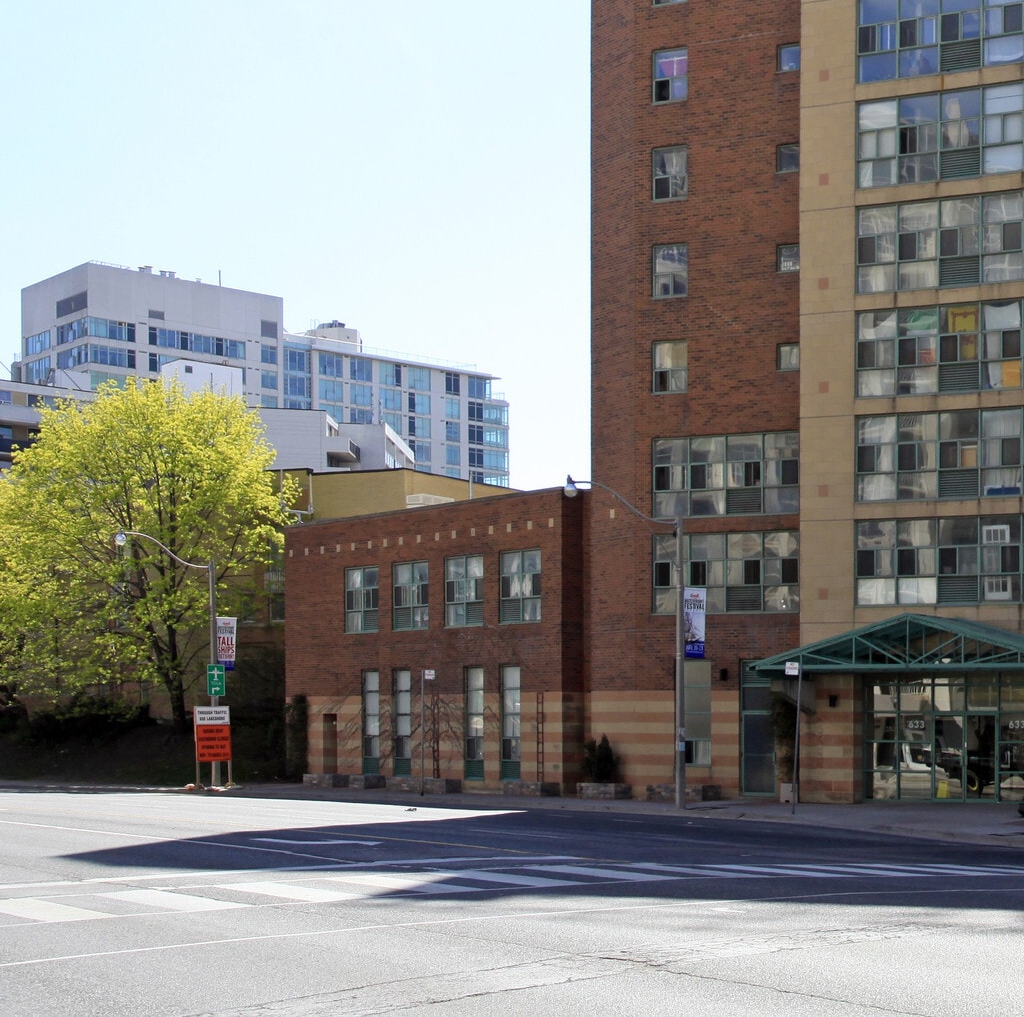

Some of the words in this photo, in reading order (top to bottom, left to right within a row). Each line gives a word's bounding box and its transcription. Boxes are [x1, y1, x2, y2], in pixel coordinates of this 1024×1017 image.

[217, 636, 235, 646] TALL
[218, 645, 235, 653] SHIPS
[908, 720, 925, 729] 633
